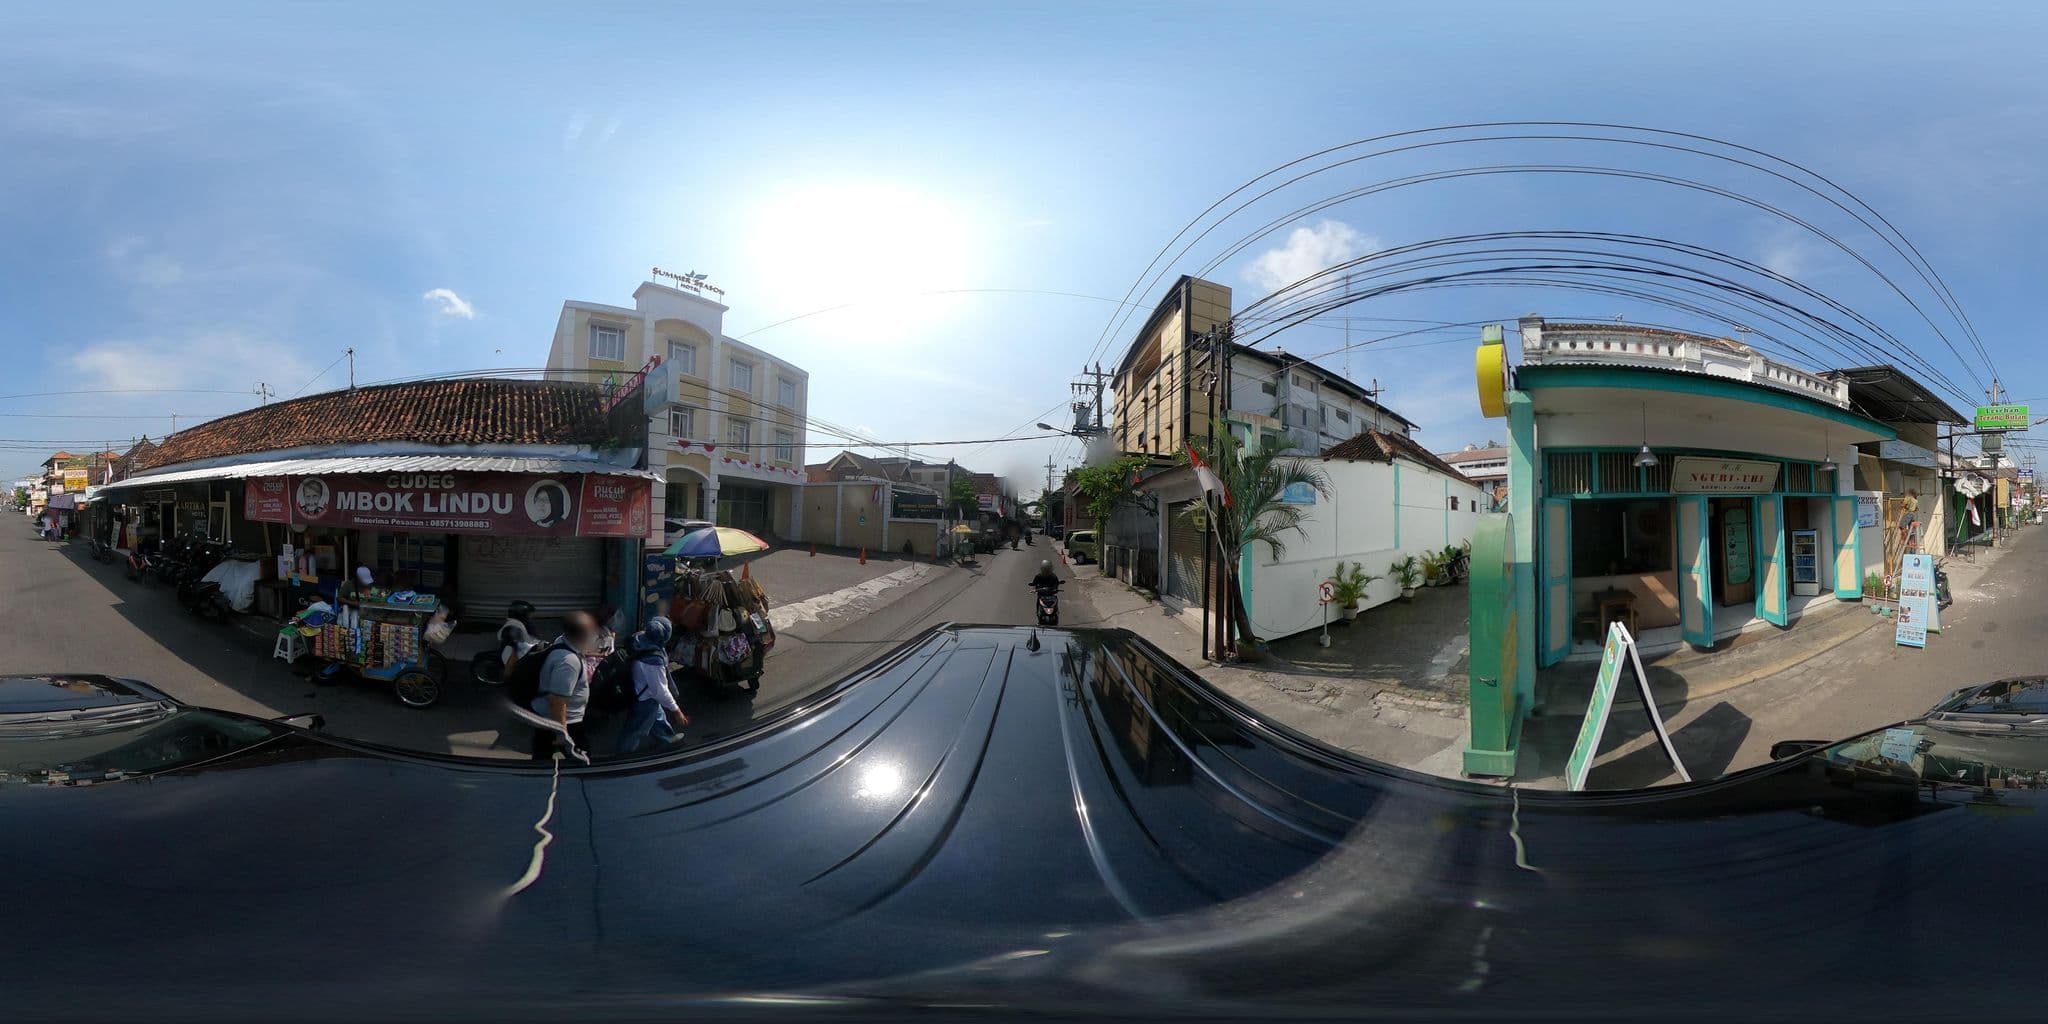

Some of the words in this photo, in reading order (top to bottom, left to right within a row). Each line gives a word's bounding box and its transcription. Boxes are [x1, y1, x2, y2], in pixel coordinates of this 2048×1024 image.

[652, 267, 691, 284] SUMMER
[692, 280, 725, 296] SEASON
[680, 283, 701, 293] HOTEL
[386, 474, 455, 489] GUDEG
[336, 491, 413, 513] MBOK
[423, 492, 513, 515] LINDU
[353, 516, 389, 525] Menerima
[391, 519, 424, 527] Pesanan
